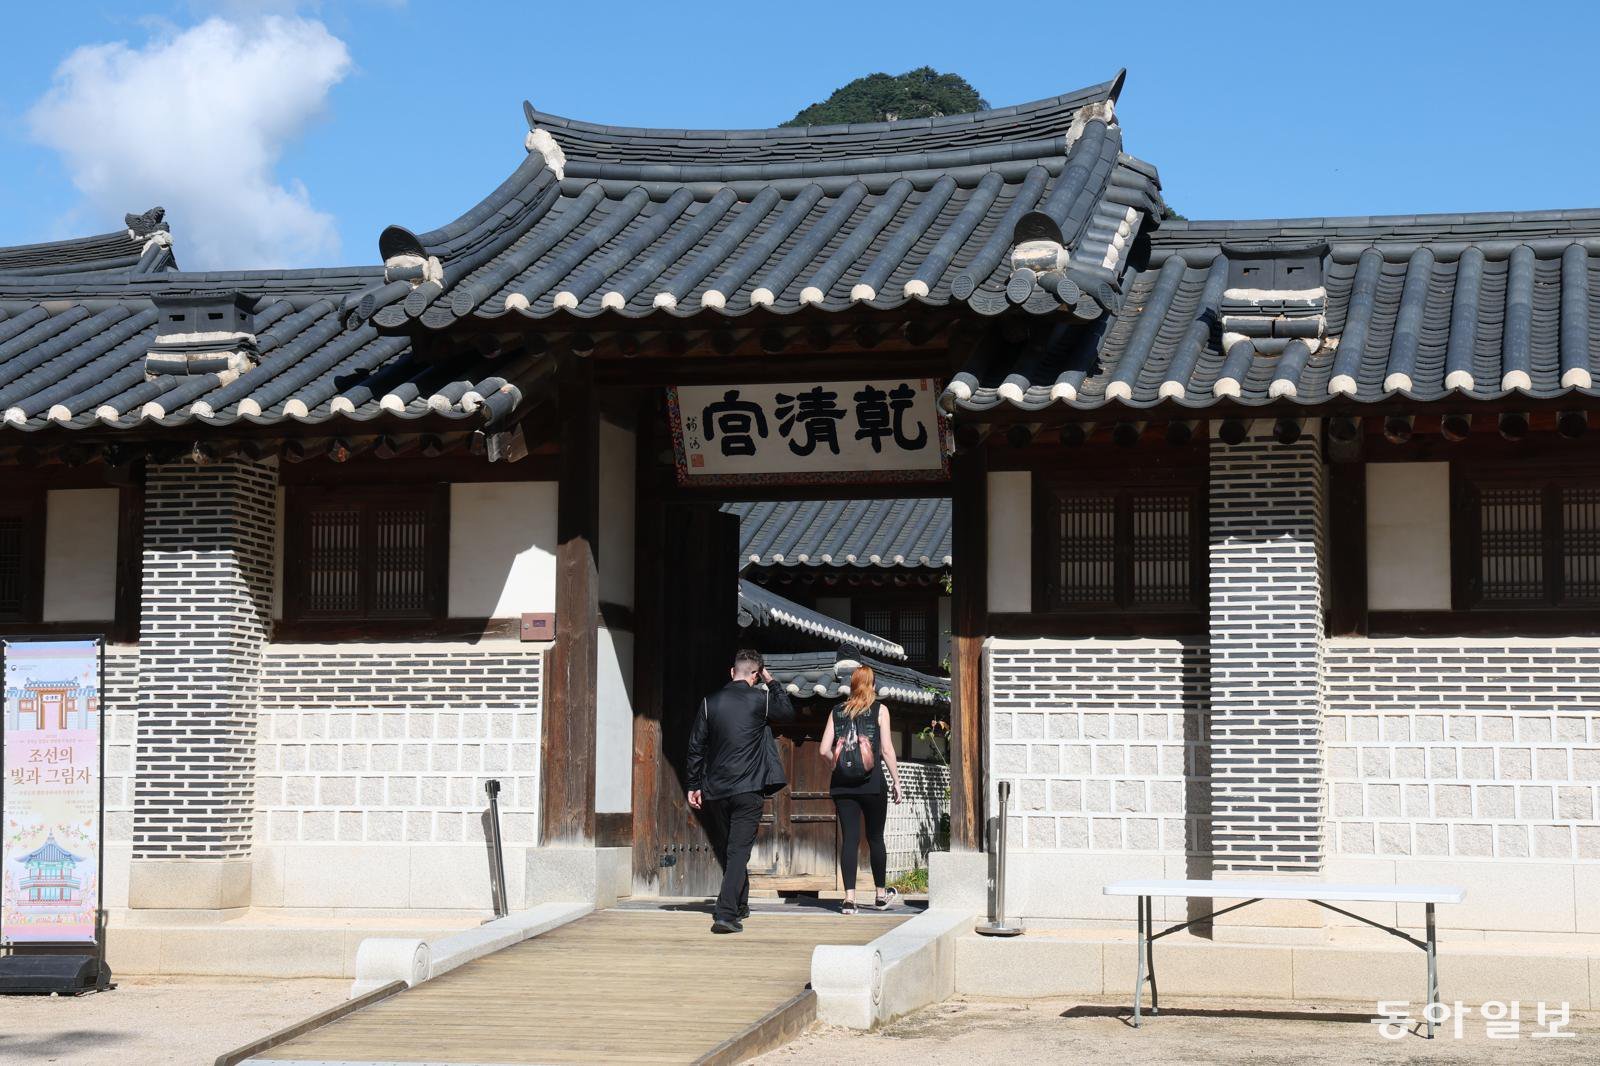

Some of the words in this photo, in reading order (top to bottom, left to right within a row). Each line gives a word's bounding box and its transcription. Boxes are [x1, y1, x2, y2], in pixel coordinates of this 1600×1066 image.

[28, 746, 73, 764] 조선의
[11, 767, 41, 785] 빛과
[45, 767, 92, 785] 그림자
